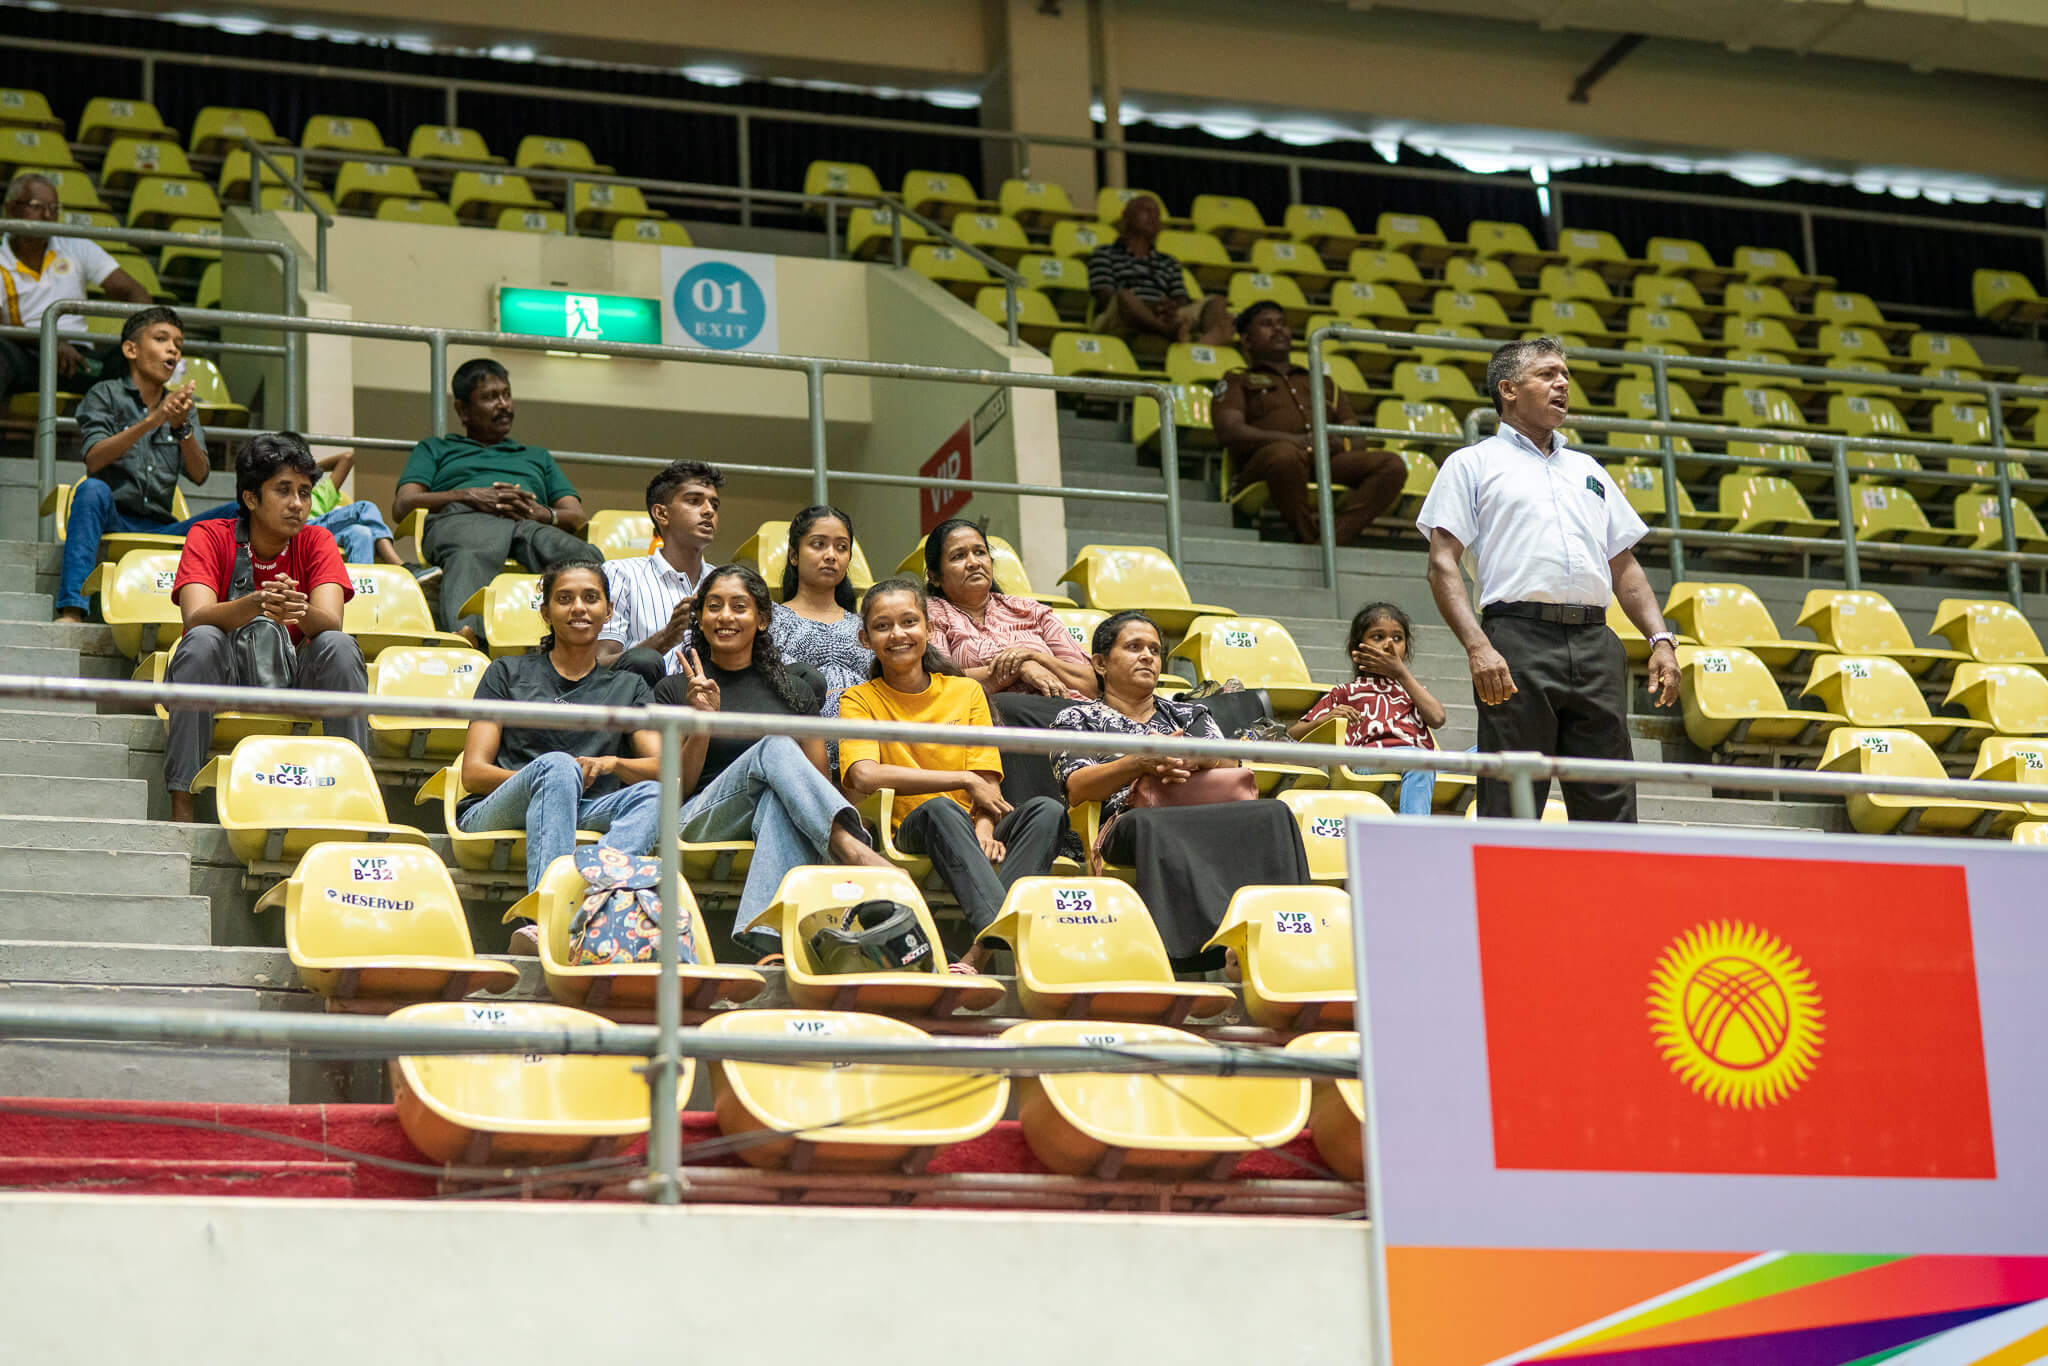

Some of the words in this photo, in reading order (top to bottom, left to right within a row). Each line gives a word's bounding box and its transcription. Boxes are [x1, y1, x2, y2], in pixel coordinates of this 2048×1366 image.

[692, 278, 748, 315] 01
[695, 321, 748, 339] EXIT
[928, 450, 961, 514] VIP
[354, 585, 374, 594] -33
[1229, 631, 1249, 639] VIP
[1225, 637, 1252, 648] E-28
[280, 764, 308, 775] VIP
[2025, 759, 2044, 769] -26
[1317, 817, 1343, 828] VIP
[357, 858, 388, 869] VIP
[354, 868, 393, 881] B-32
[1058, 889, 1088, 899] VIP
[341, 891, 415, 911] RESERVED
[1056, 899, 1092, 911] B-29
[1279, 911, 1306, 922] VIP
[1277, 921, 1313, 933] B-28
[472, 1009, 505, 1020] VIP
[793, 1022, 825, 1032] VIP
